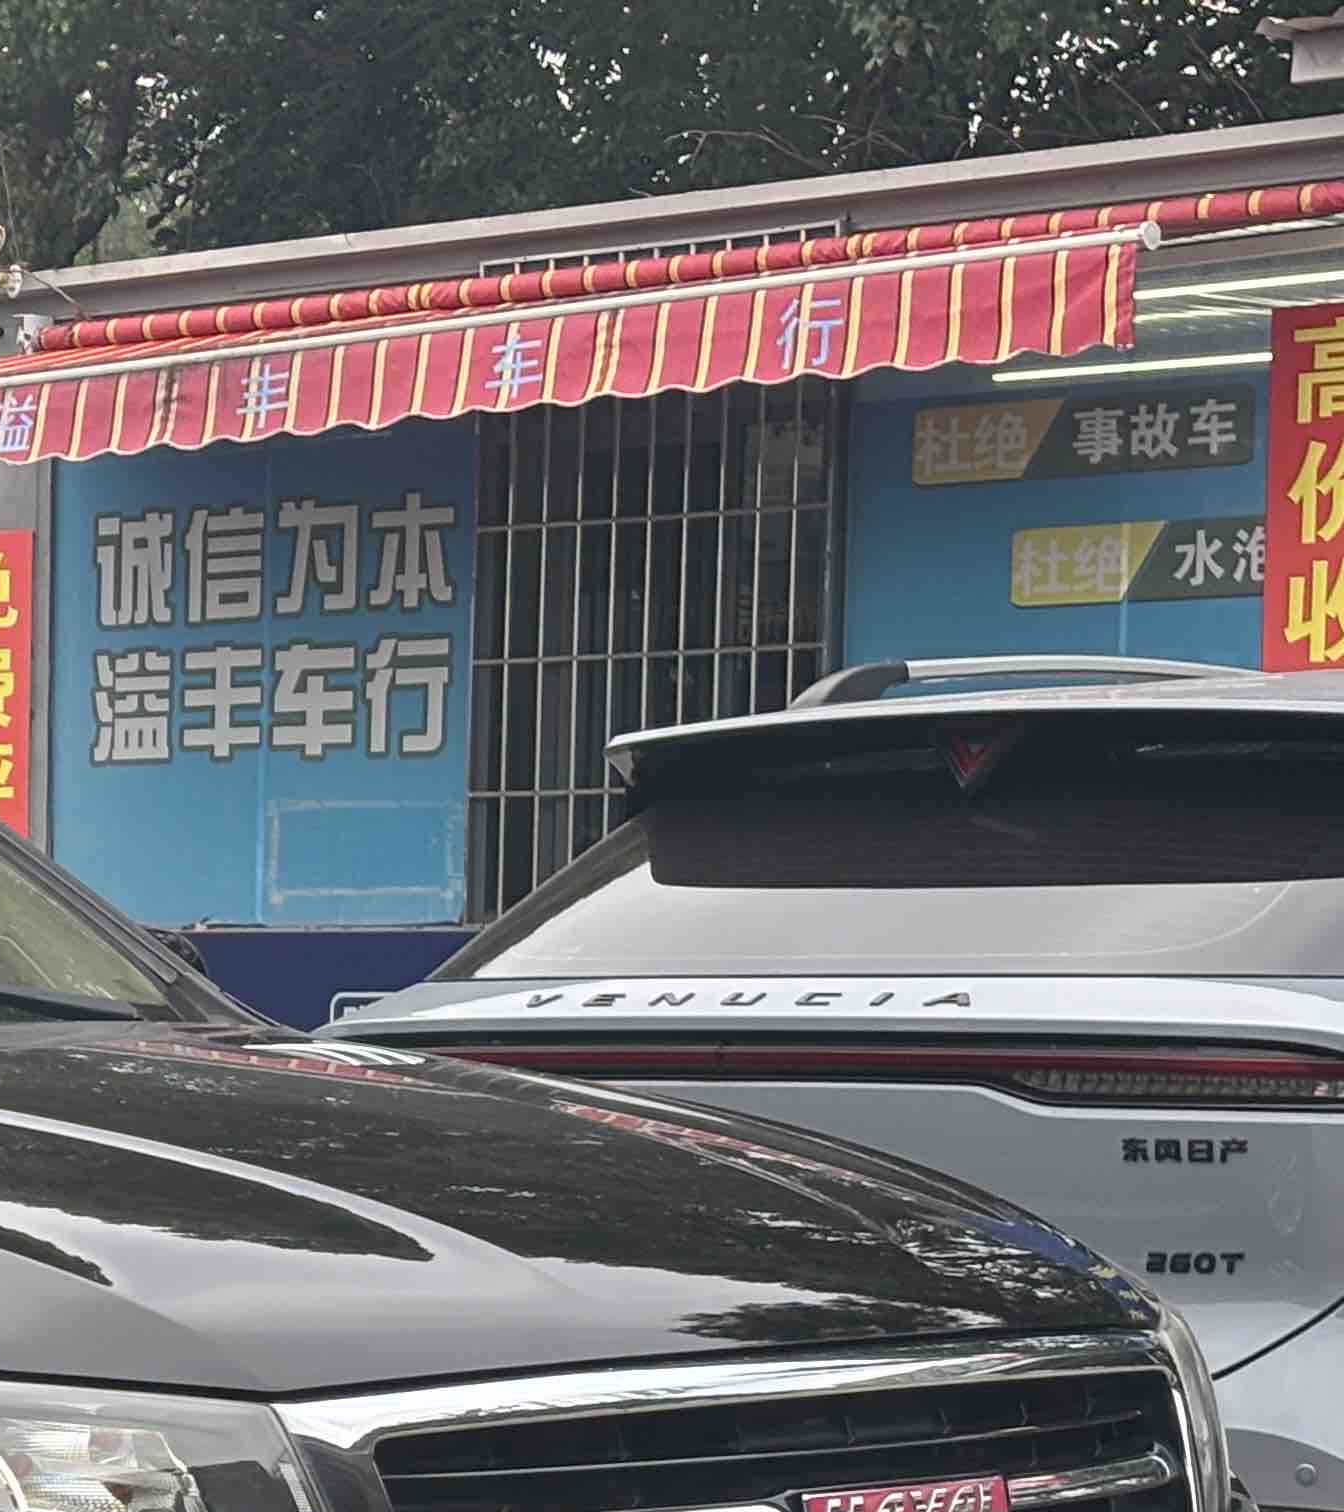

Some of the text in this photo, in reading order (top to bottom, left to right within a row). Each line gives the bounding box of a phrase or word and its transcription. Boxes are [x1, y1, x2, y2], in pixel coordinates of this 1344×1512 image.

[914, 398, 1238, 475] 杜绝 事故车
[95, 493, 455, 625] 诚信为本
[1016, 532, 1127, 597] 杜绝
[92, 636, 451, 765] 溢丰车行
[525, 990, 974, 1009] VENUCIA
[1120, 1136, 1249, 1164] 东风日产
[1146, 1252, 1245, 1276] 260T
